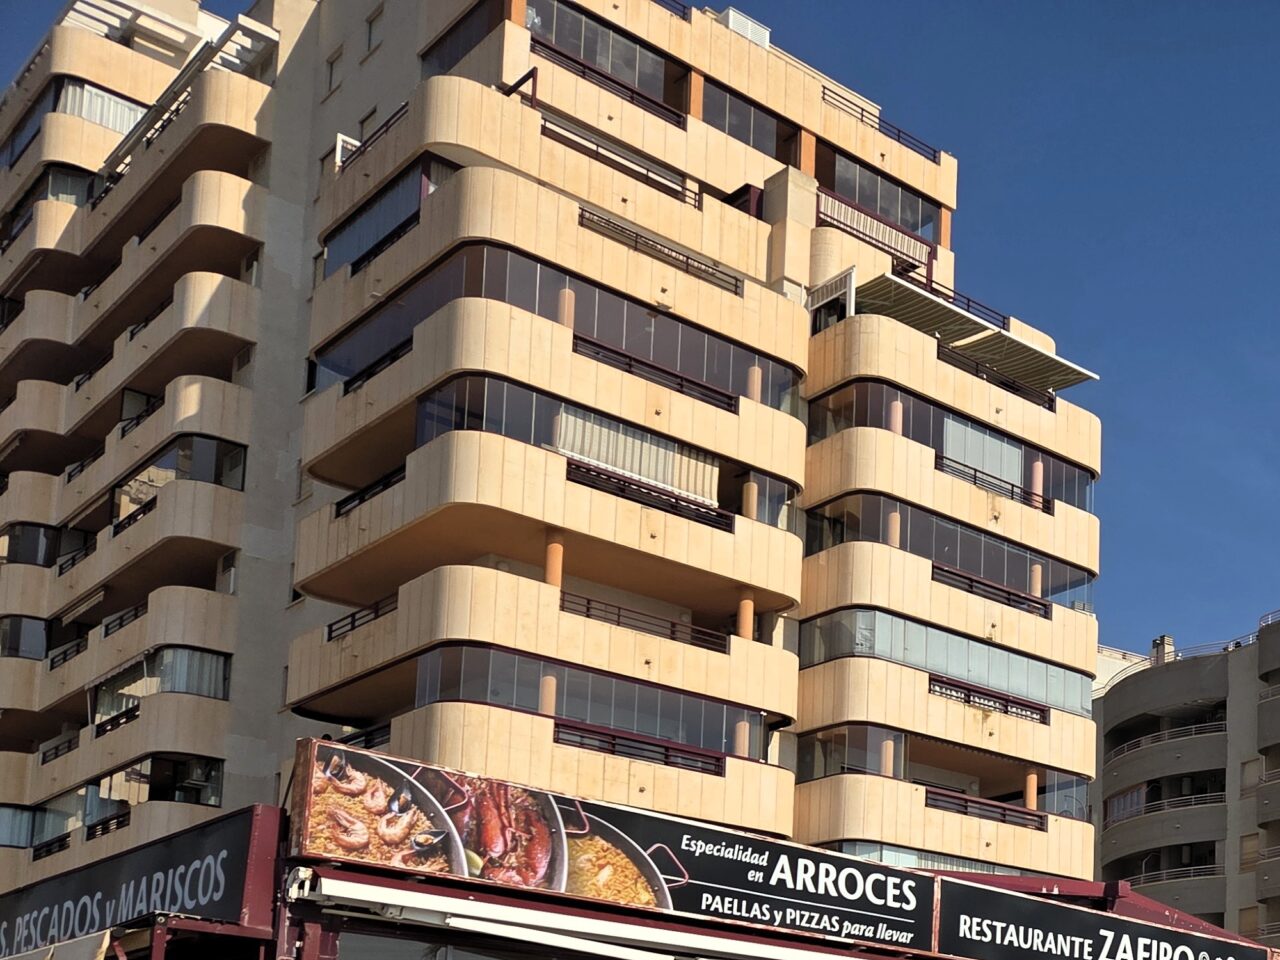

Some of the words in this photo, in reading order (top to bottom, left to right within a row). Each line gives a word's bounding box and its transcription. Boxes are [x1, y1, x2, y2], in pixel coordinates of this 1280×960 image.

[681, 834, 769, 867] Especialidad
[13, 892, 102, 955] PESCADOS
[117, 849, 228, 924] MARISCOS
[747, 867, 764, 884] en
[769, 854, 917, 911] ARROCES
[701, 893, 770, 921] PAELLAS
[773, 909, 783, 926] y
[786, 908, 840, 932] PIZZAS
[841, 921, 874, 938] para
[876, 924, 914, 944] llevar
[959, 914, 1093, 960] RESTAURANTE
